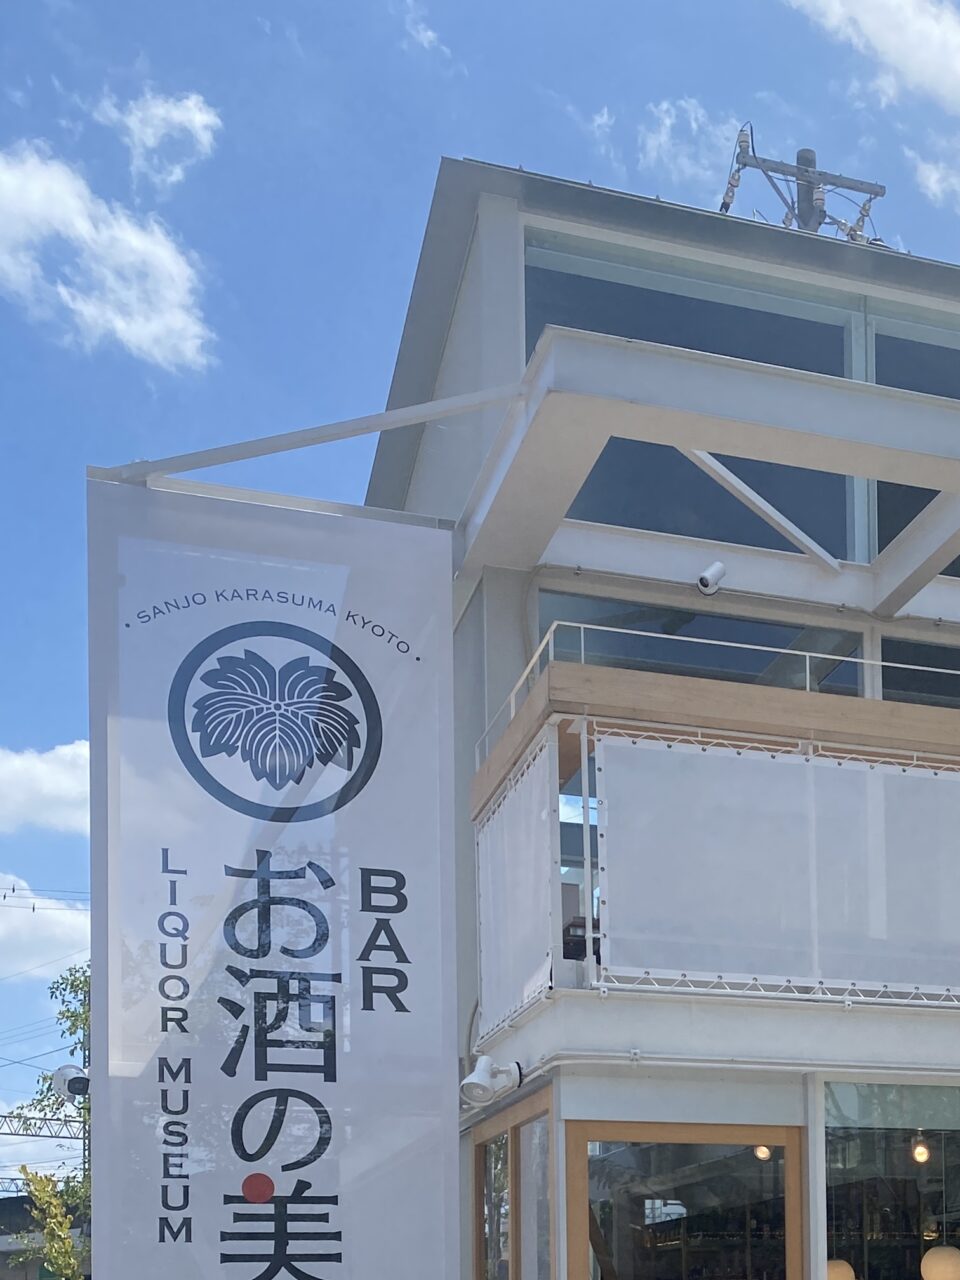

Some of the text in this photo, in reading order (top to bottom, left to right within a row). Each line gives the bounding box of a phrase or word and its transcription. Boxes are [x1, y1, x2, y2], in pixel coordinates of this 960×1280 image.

[136, 588, 410, 654] SANJO KARASUMA KYOTO
[356, 867, 412, 1013] BAR
[157, 847, 193, 1243] LIQUOR MUSEUM
